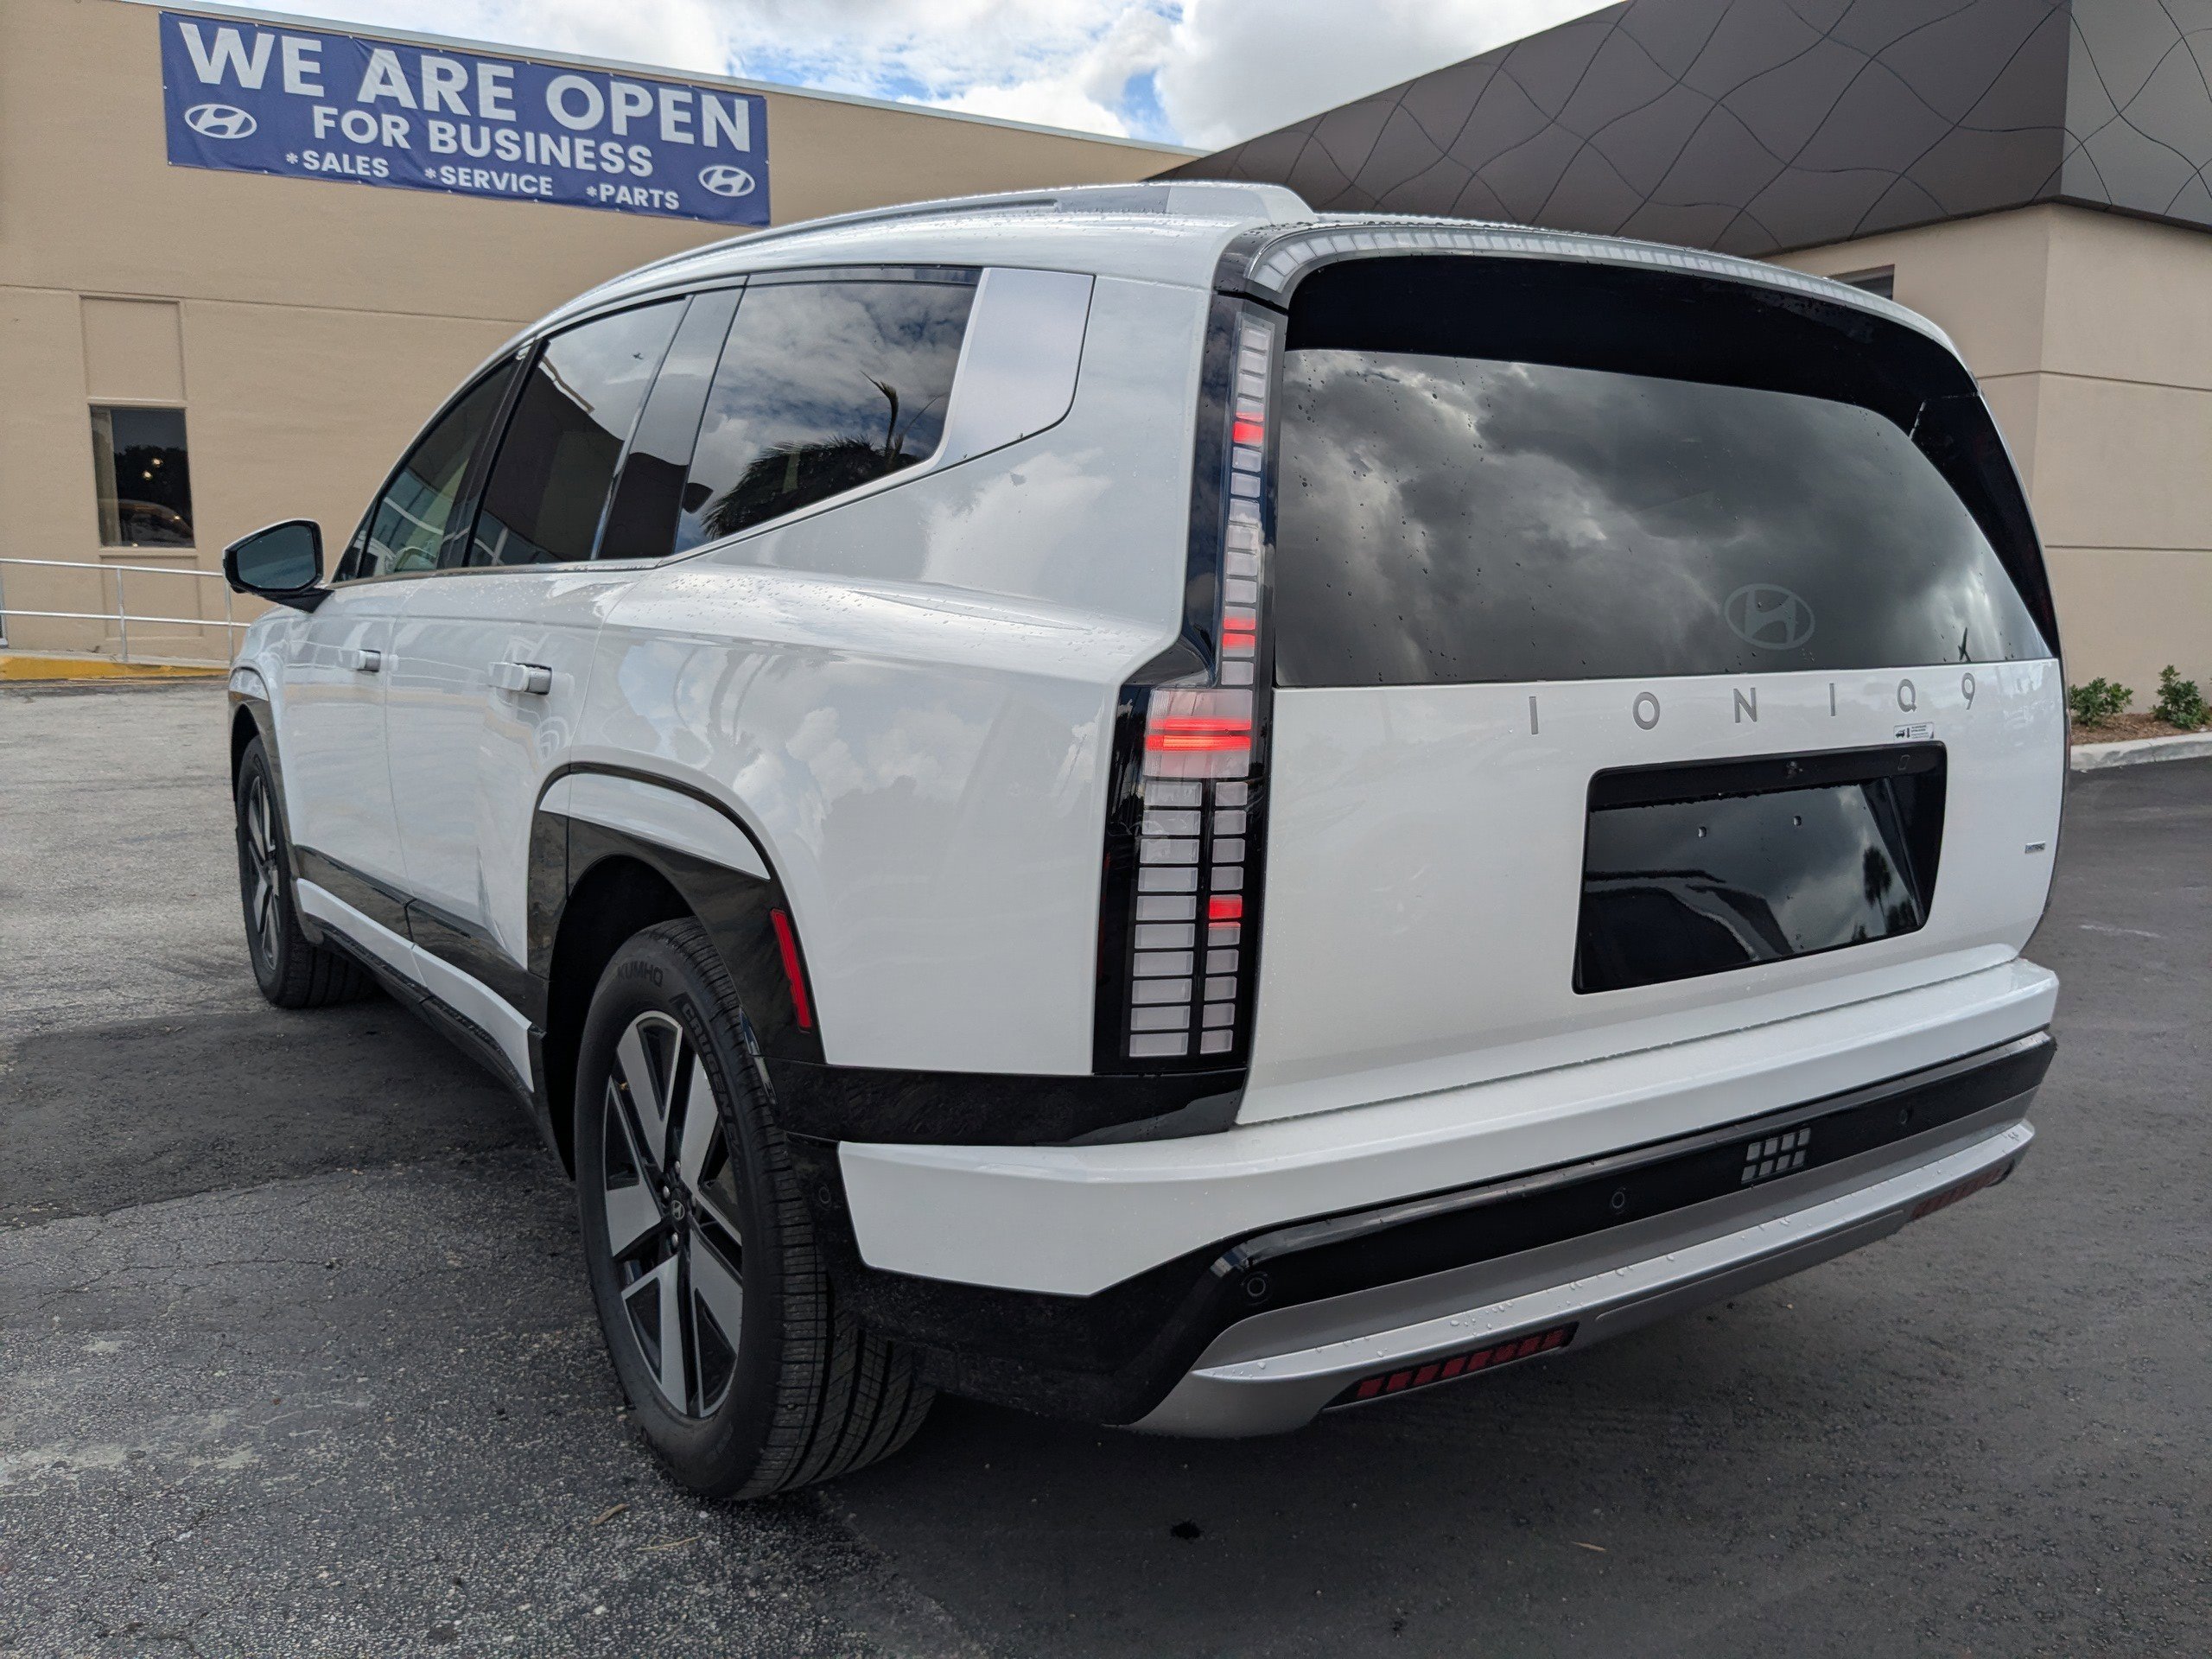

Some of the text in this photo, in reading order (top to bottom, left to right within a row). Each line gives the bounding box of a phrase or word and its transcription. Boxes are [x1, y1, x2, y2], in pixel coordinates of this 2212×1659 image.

[178, 22, 751, 152] WE ARE OPEN
[313, 105, 653, 177] FOR BUSINESS
[616, 960, 664, 986] KUMHO
